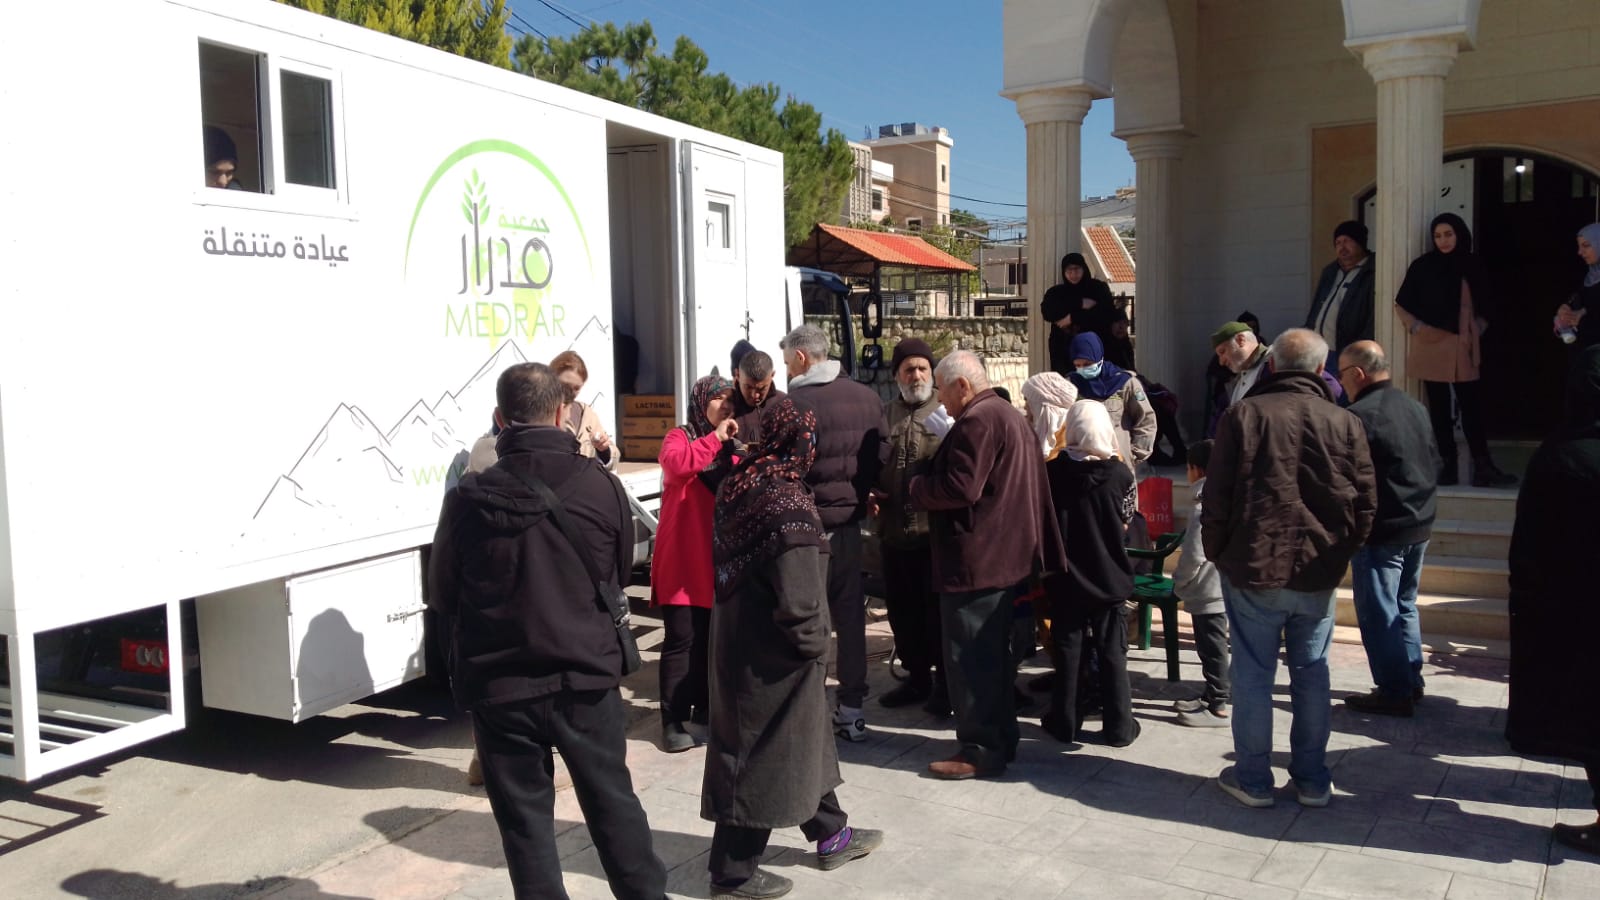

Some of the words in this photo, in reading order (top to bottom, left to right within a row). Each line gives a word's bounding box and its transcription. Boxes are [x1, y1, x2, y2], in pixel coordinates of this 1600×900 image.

[498, 206, 550, 235] جمعية
[202, 226, 286, 258] متنقلة
[293, 233, 349, 267] عيادة
[457, 202, 553, 296] مدرار
[445, 301, 566, 338] MEDRAR
